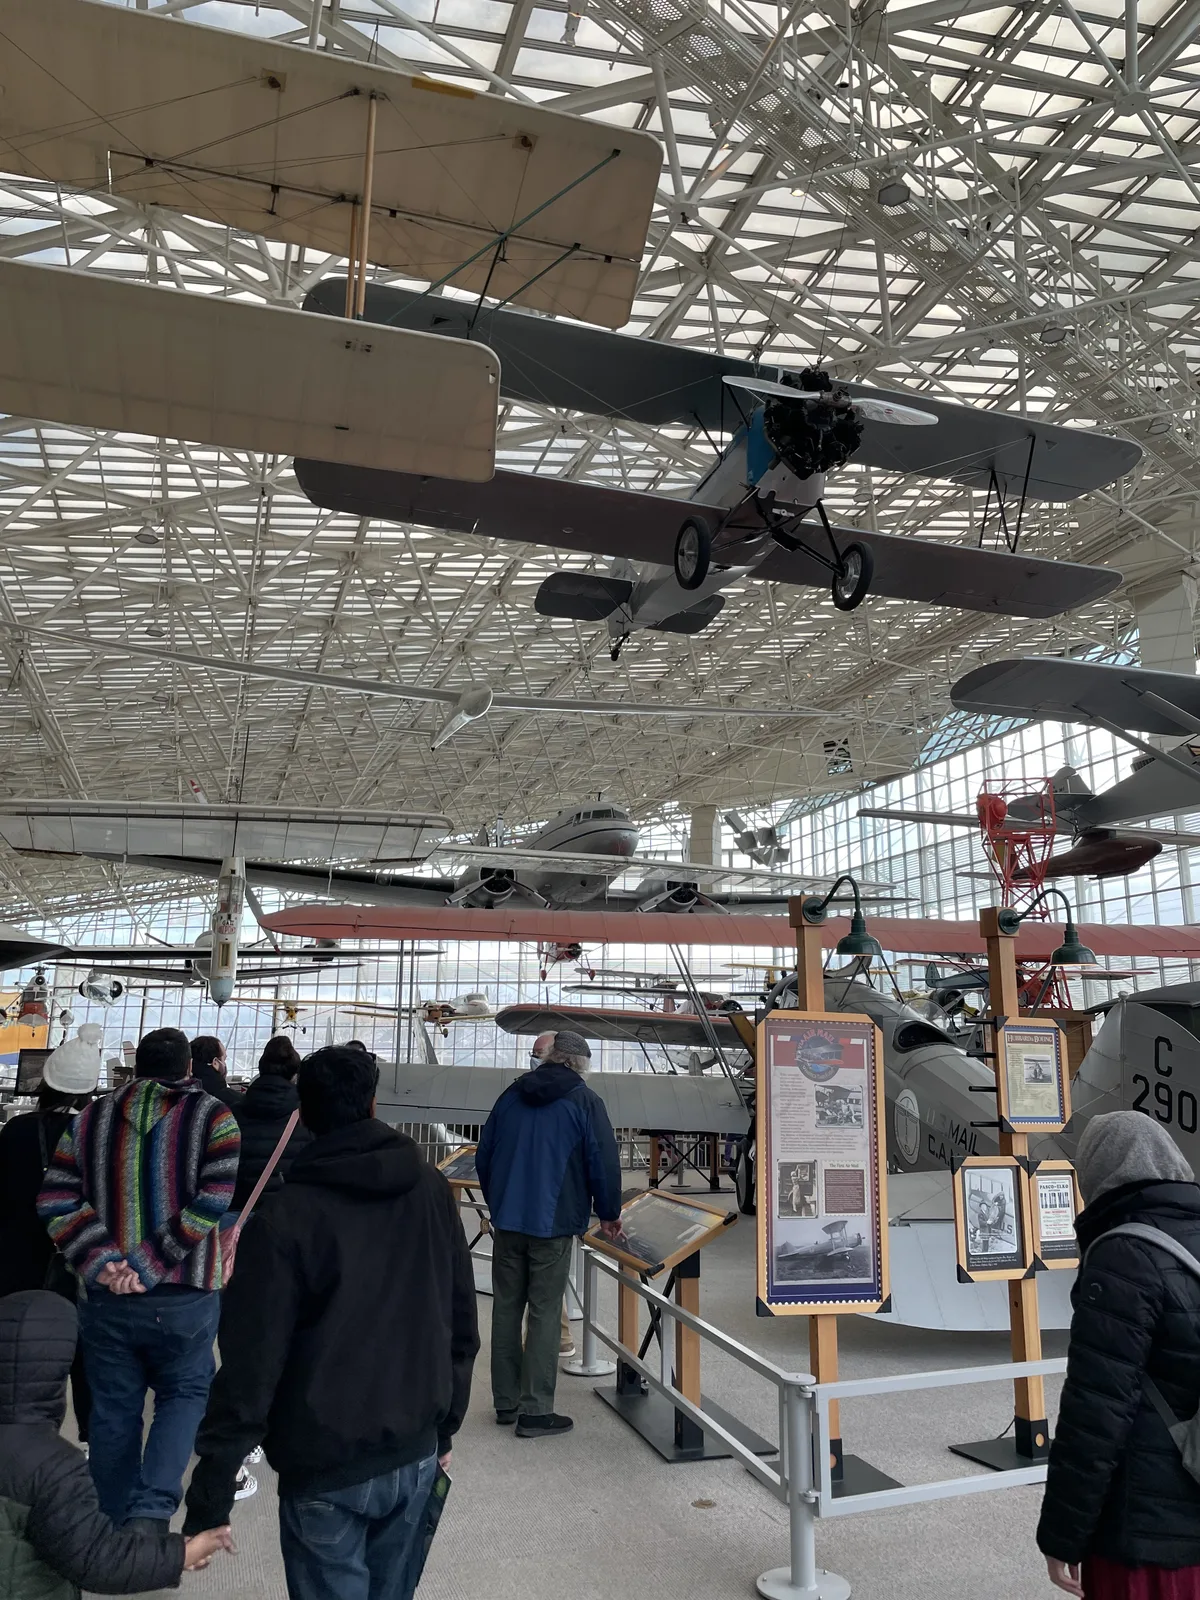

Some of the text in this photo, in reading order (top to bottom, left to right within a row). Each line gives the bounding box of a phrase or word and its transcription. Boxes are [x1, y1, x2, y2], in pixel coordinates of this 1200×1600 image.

[802, 1028, 816, 1041] AIR
[817, 1029, 835, 1044] MAIL
[1154, 1035, 1173, 1078] C
[1132, 1073, 1198, 1134] 290
[947, 1119, 980, 1157] MAIL
